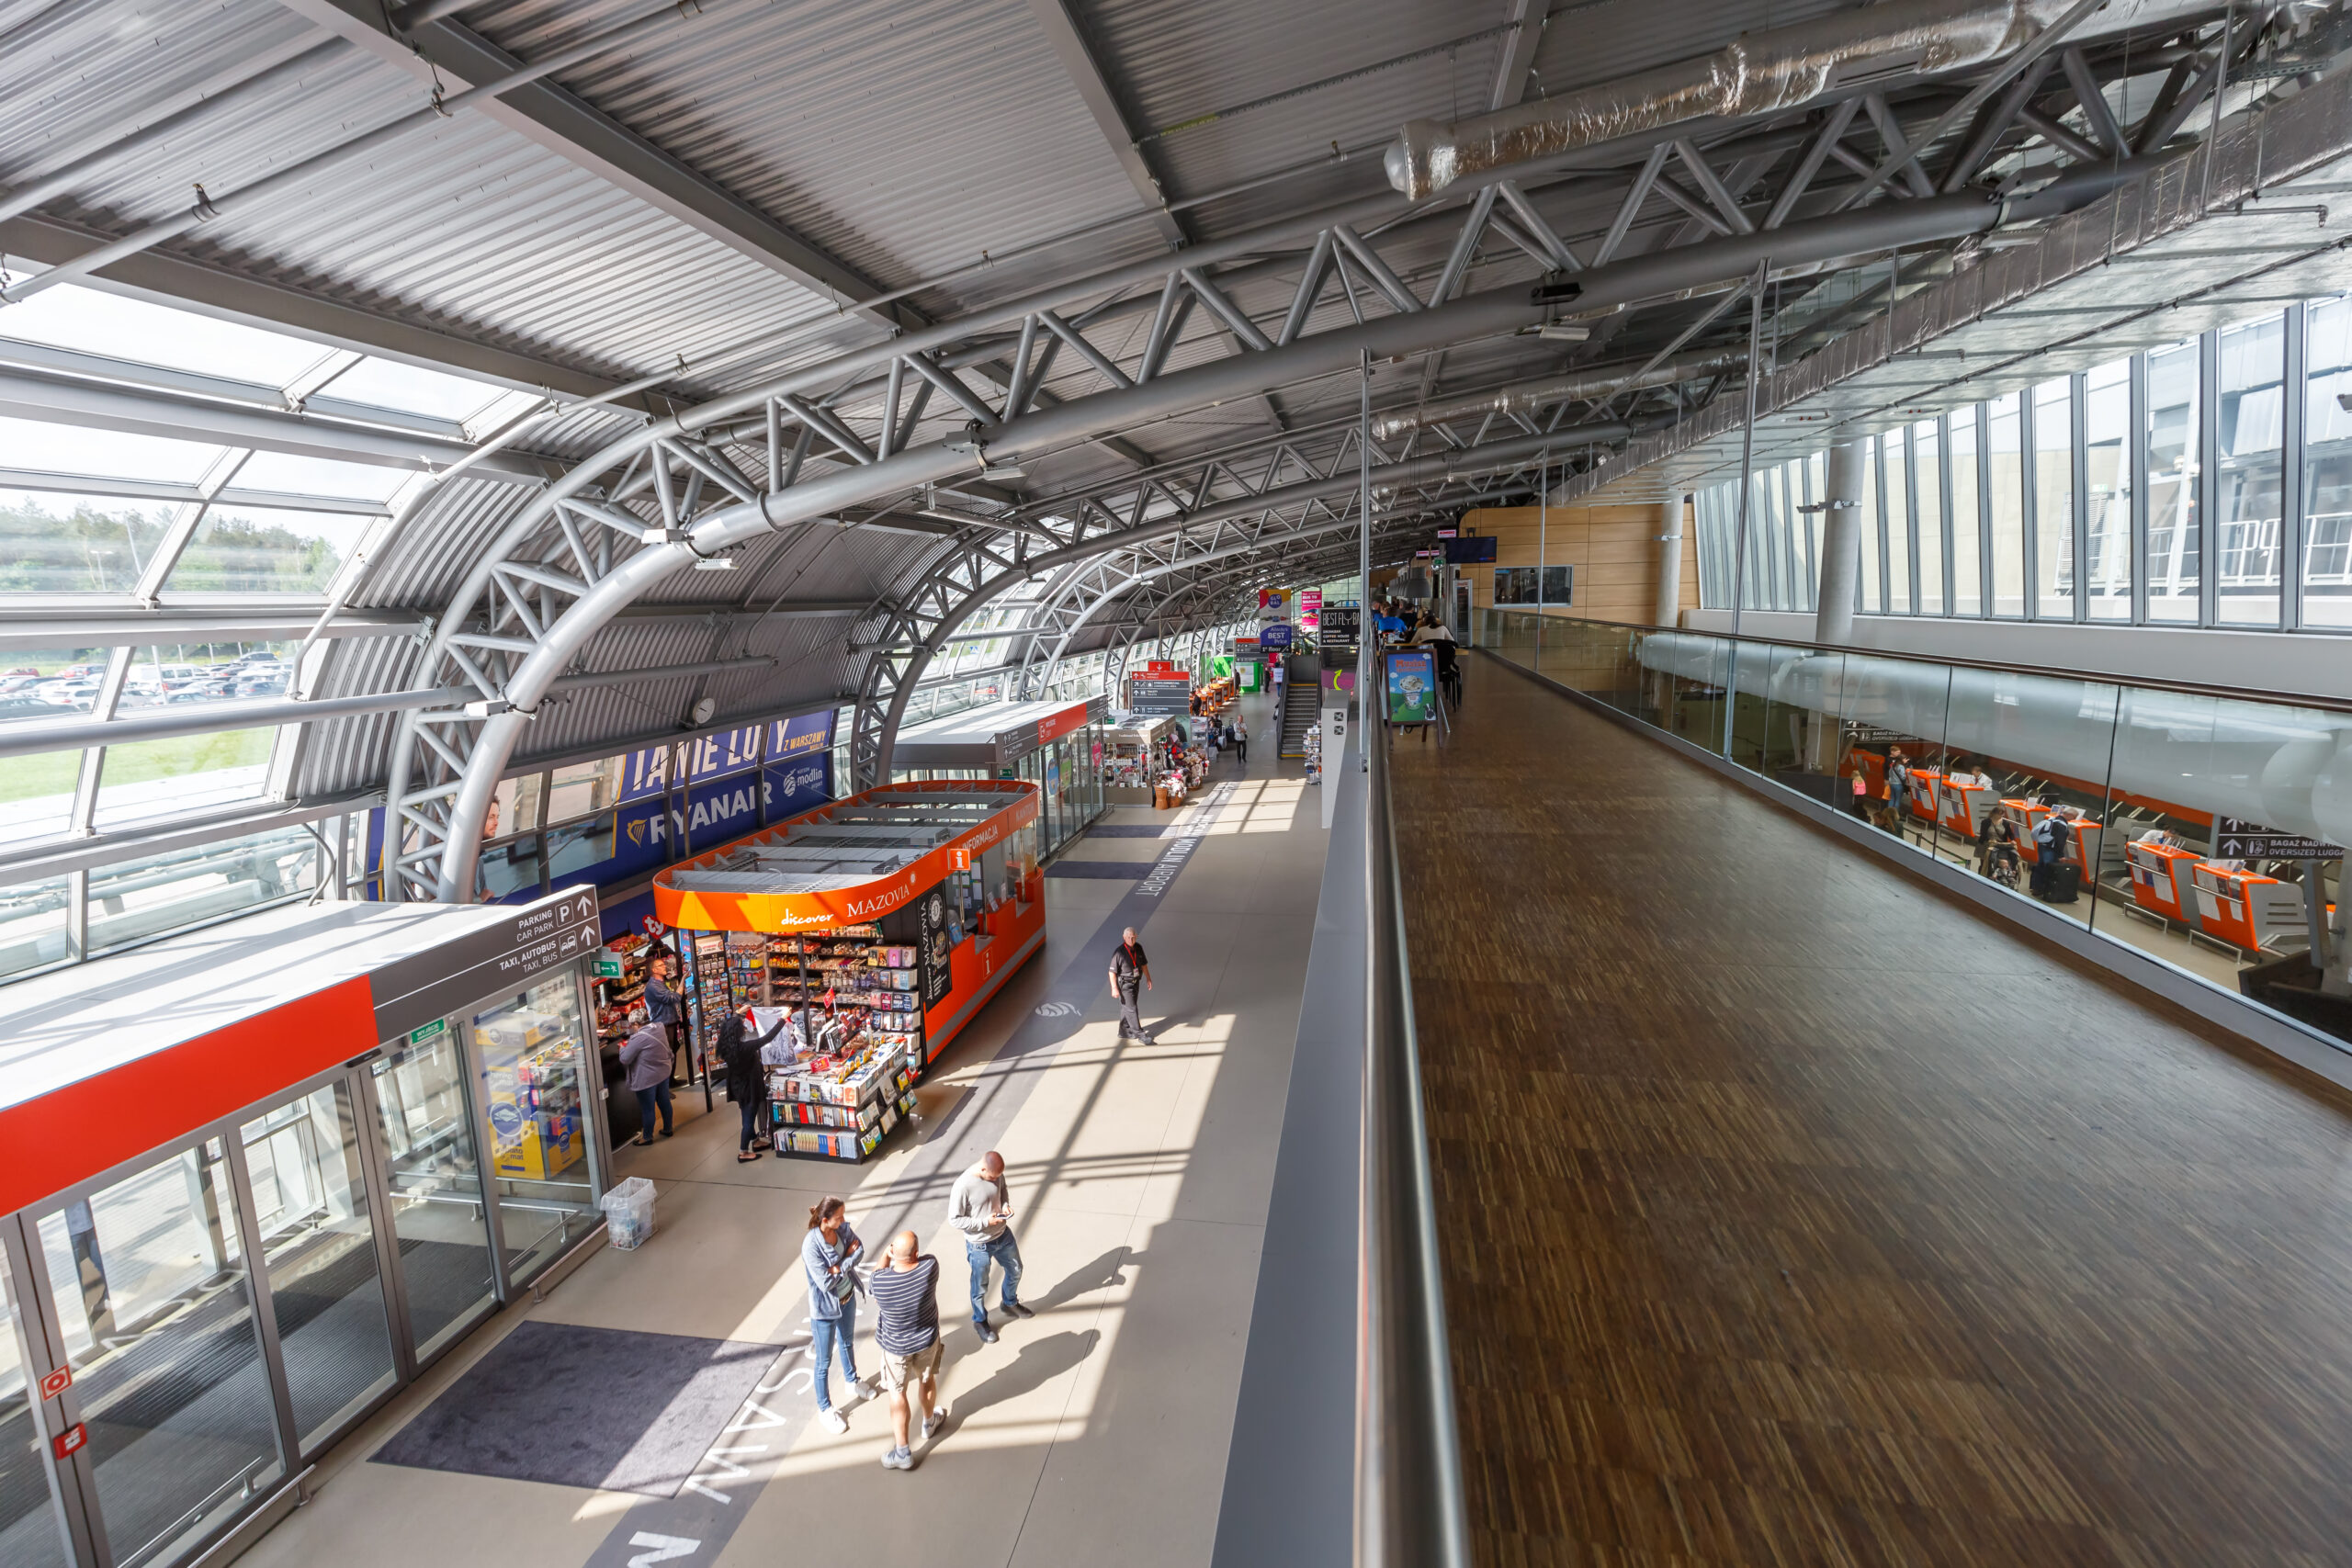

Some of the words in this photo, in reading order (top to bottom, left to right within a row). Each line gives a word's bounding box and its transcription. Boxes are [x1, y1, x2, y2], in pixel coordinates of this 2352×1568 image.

[783, 739, 789, 751] Z
[789, 729, 827, 750] WARSZAWY
[797, 768, 823, 786] modlin
[650, 782, 773, 844] RYANAIR
[962, 824, 999, 851] INFORMACJA
[2270, 839, 2301, 847] BAGAŻ
[1163, 838, 1198, 863] MODLIN
[1135, 863, 1178, 897] AIRPORT
[781, 908, 835, 926] discover
[846, 884, 910, 918] MAZOVIA
[518, 909, 553, 930] PARKING
[644, 917, 664, 936] ty
[516, 930, 533, 942] CAR
[534, 921, 554, 936] PARK
[920, 901, 933, 966] MAZOVIA
[499, 953, 521, 971] TAXI,
[521, 941, 557, 963] AUTOBUS
[522, 959, 542, 974] TAXI,
[542, 952, 559, 965] BUS
